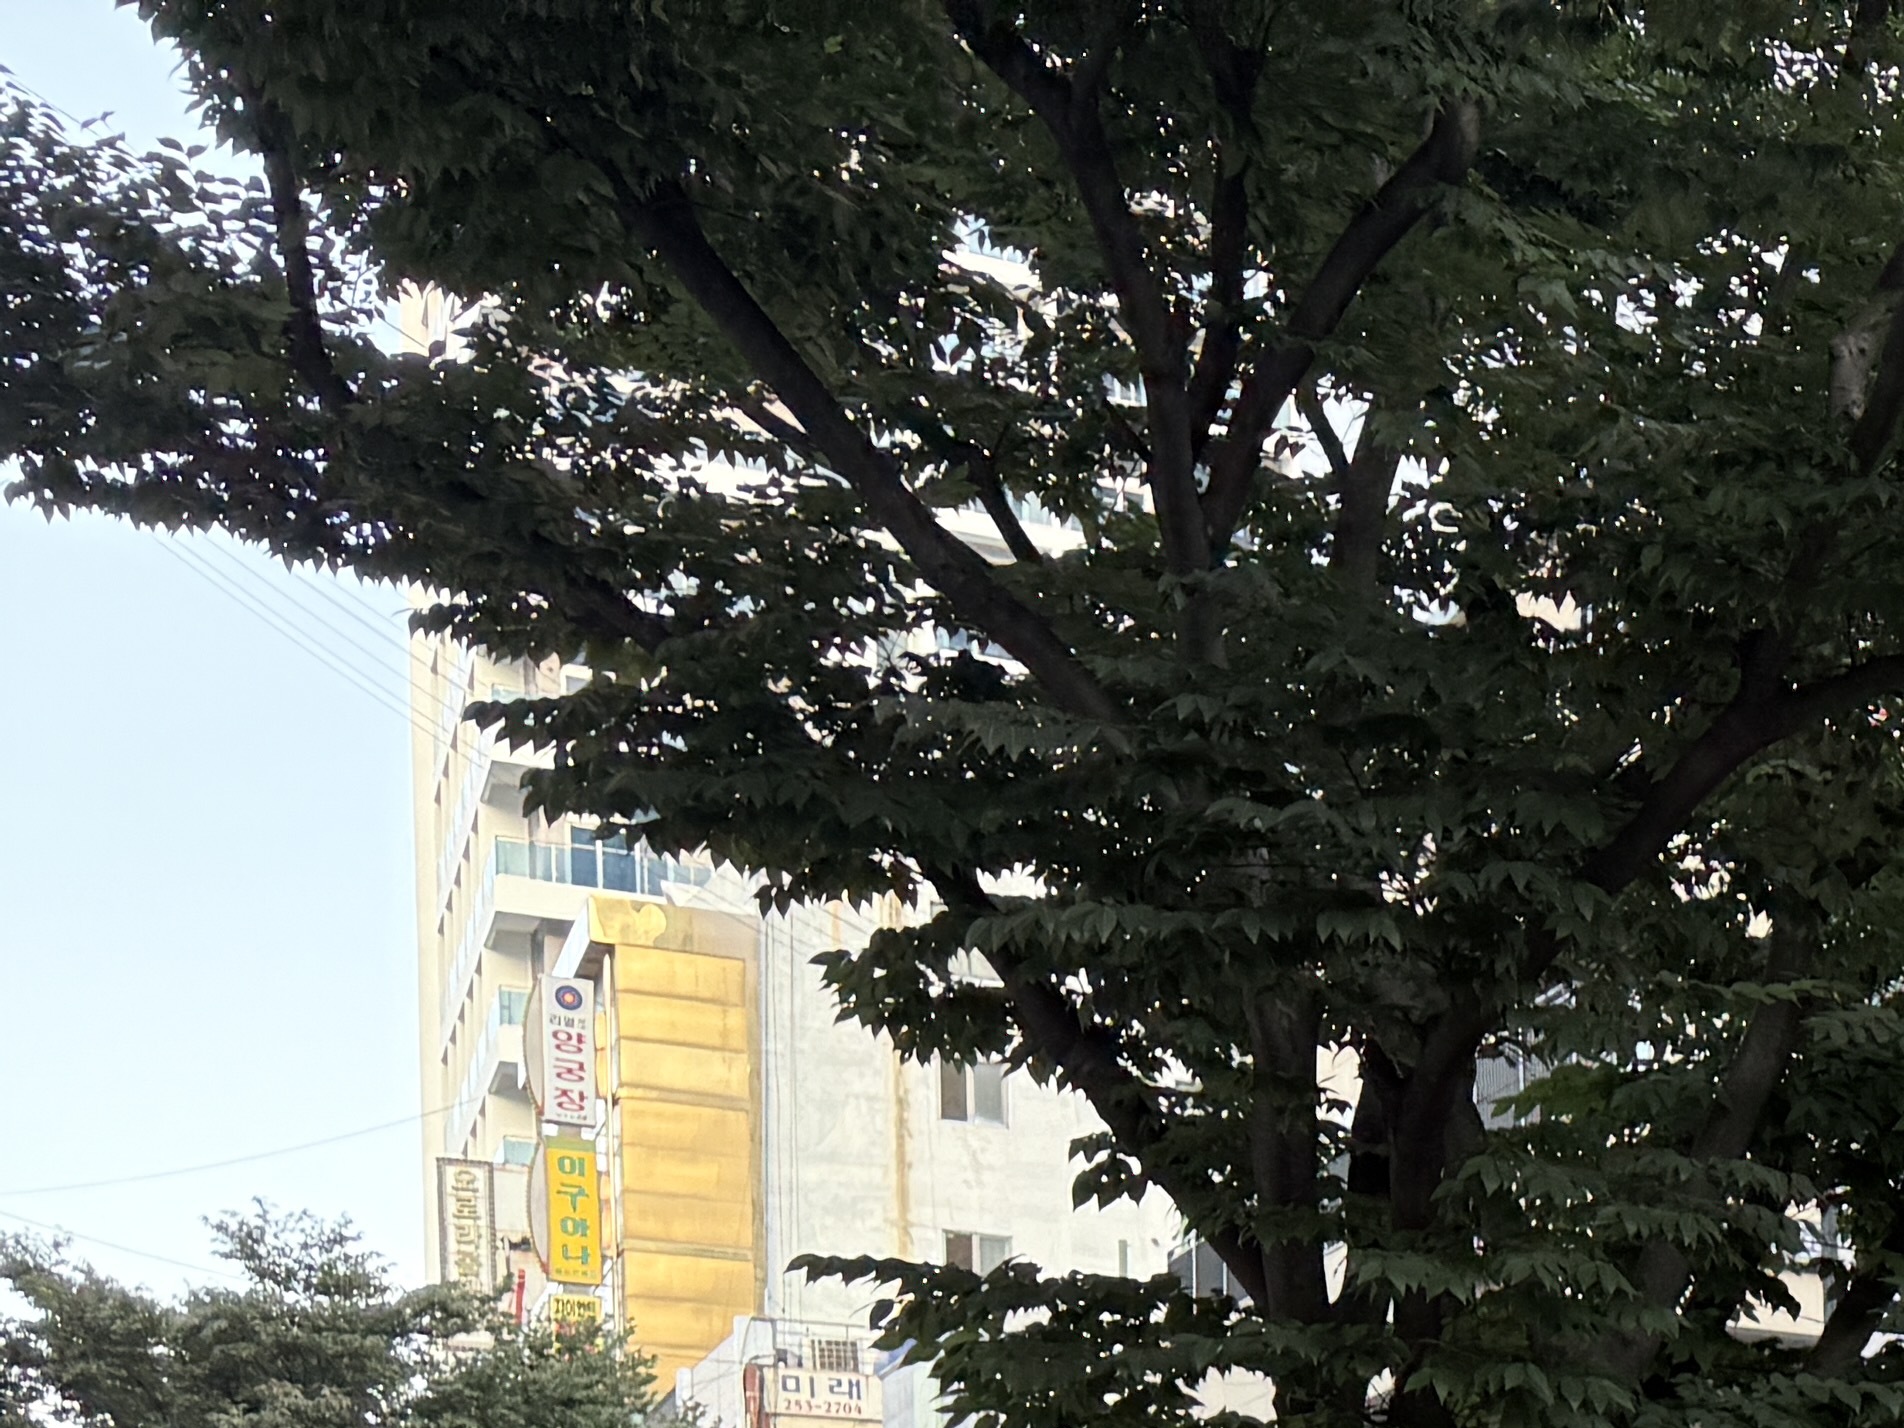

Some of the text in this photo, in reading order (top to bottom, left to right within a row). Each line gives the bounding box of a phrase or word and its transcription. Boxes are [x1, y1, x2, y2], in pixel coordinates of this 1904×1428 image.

[552, 1028, 587, 1113] 양궁장
[557, 1155, 590, 1266] 이구아나
[781, 1374, 861, 1401] 미래
